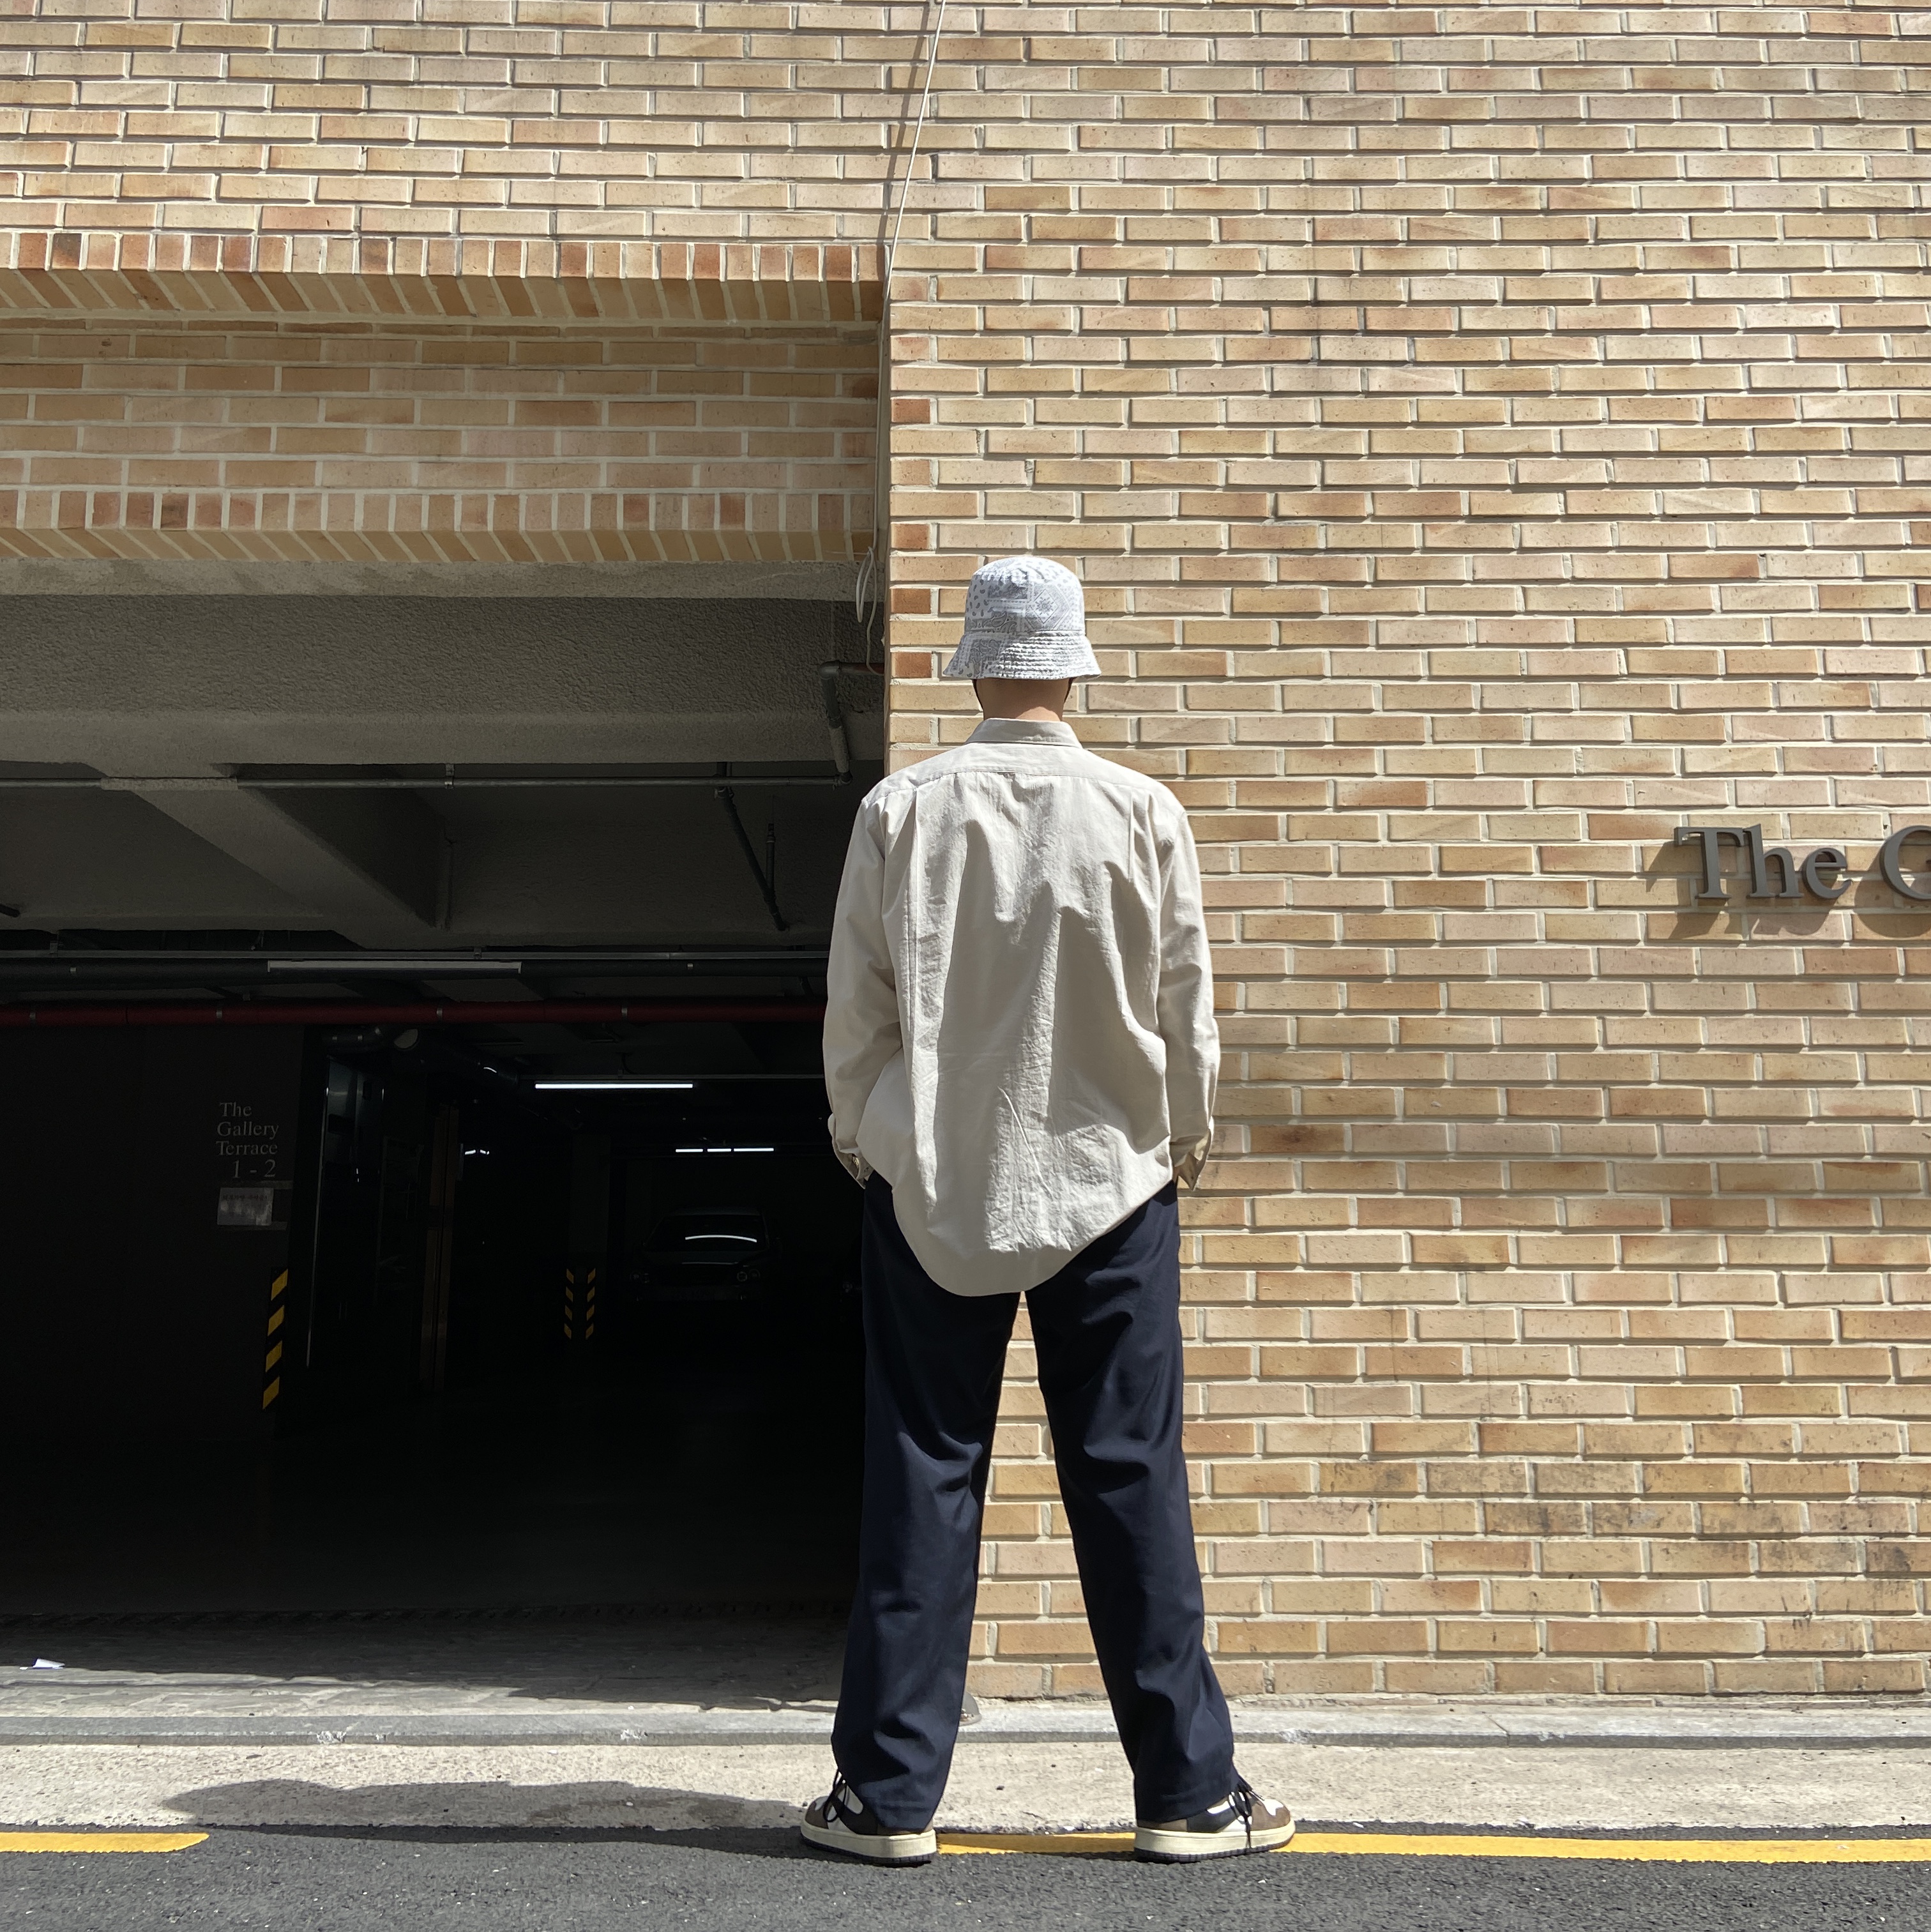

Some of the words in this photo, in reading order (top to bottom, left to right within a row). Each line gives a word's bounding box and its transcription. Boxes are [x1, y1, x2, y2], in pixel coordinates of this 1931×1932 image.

[1674, 823, 1852, 900] The
[219, 1101, 252, 1117] The
[217, 1121, 279, 1140] Gallery
[216, 1140, 278, 1155] Terrace
